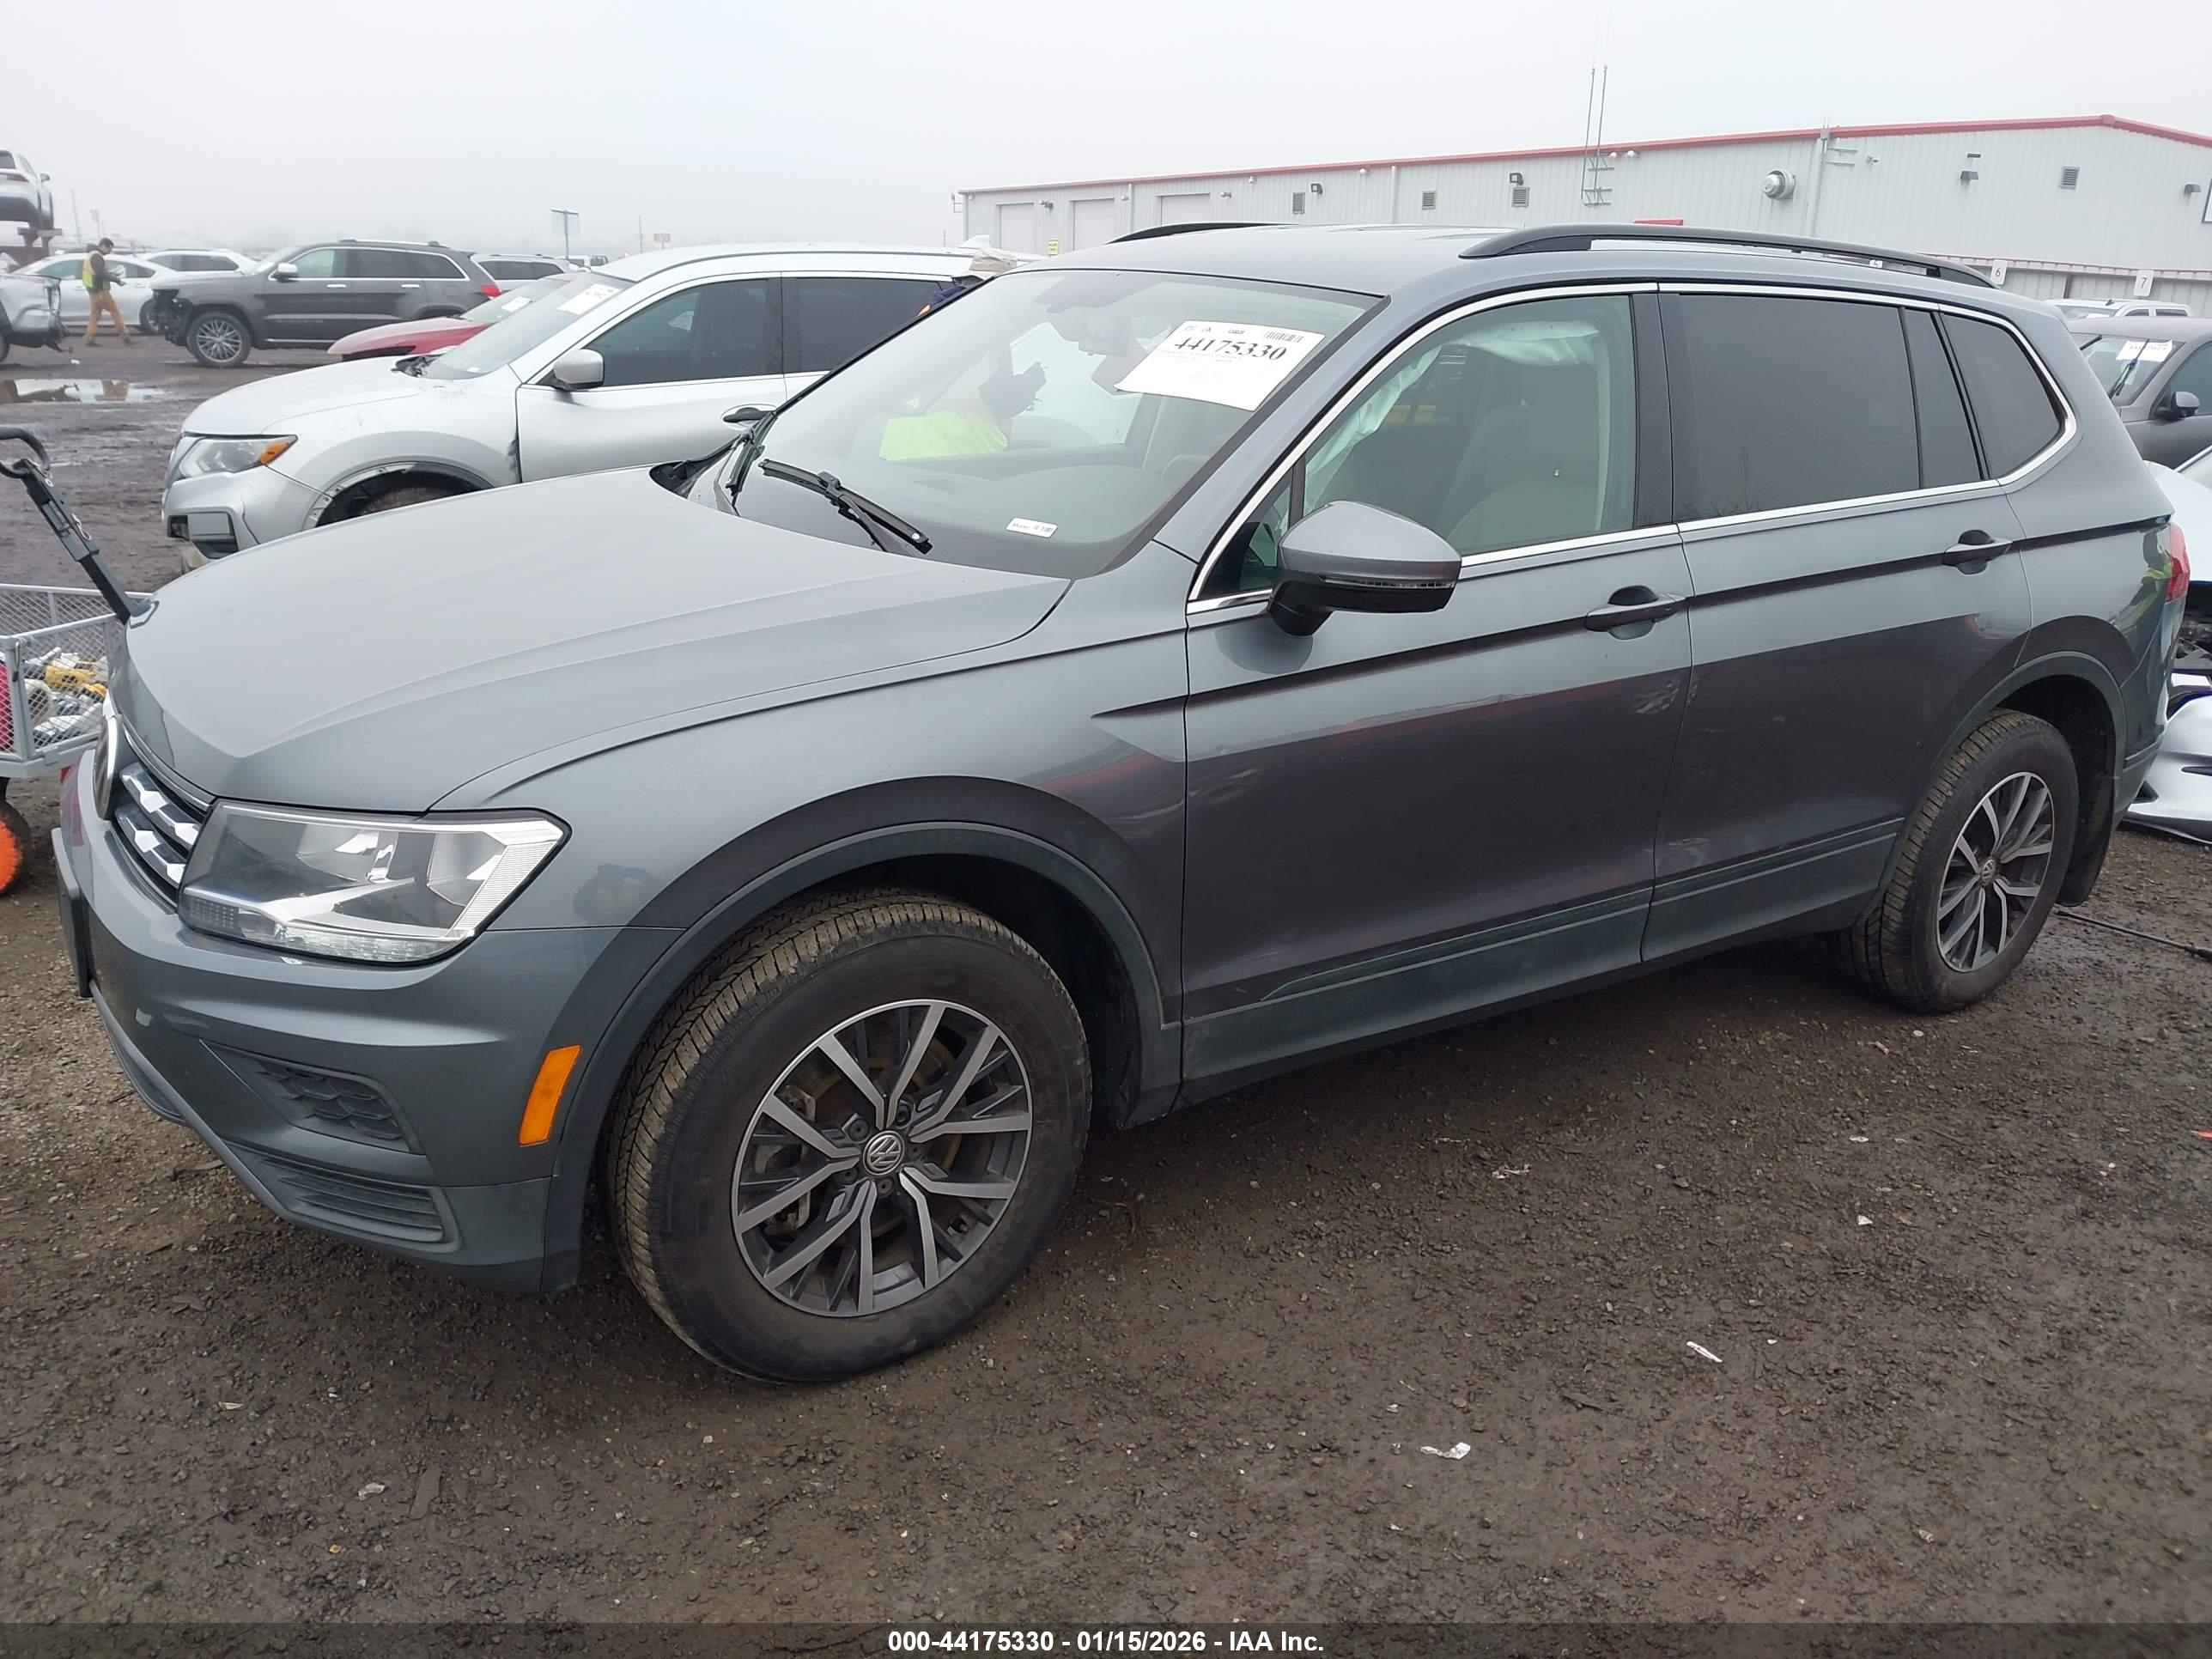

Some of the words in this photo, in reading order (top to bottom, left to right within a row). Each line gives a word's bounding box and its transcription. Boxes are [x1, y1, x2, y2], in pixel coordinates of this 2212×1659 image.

[1995, 267, 2001, 277] 6
[2141, 276, 2148, 289] 7
[1175, 337, 1287, 361] 44175330
[866, 1133, 902, 1170] VW
